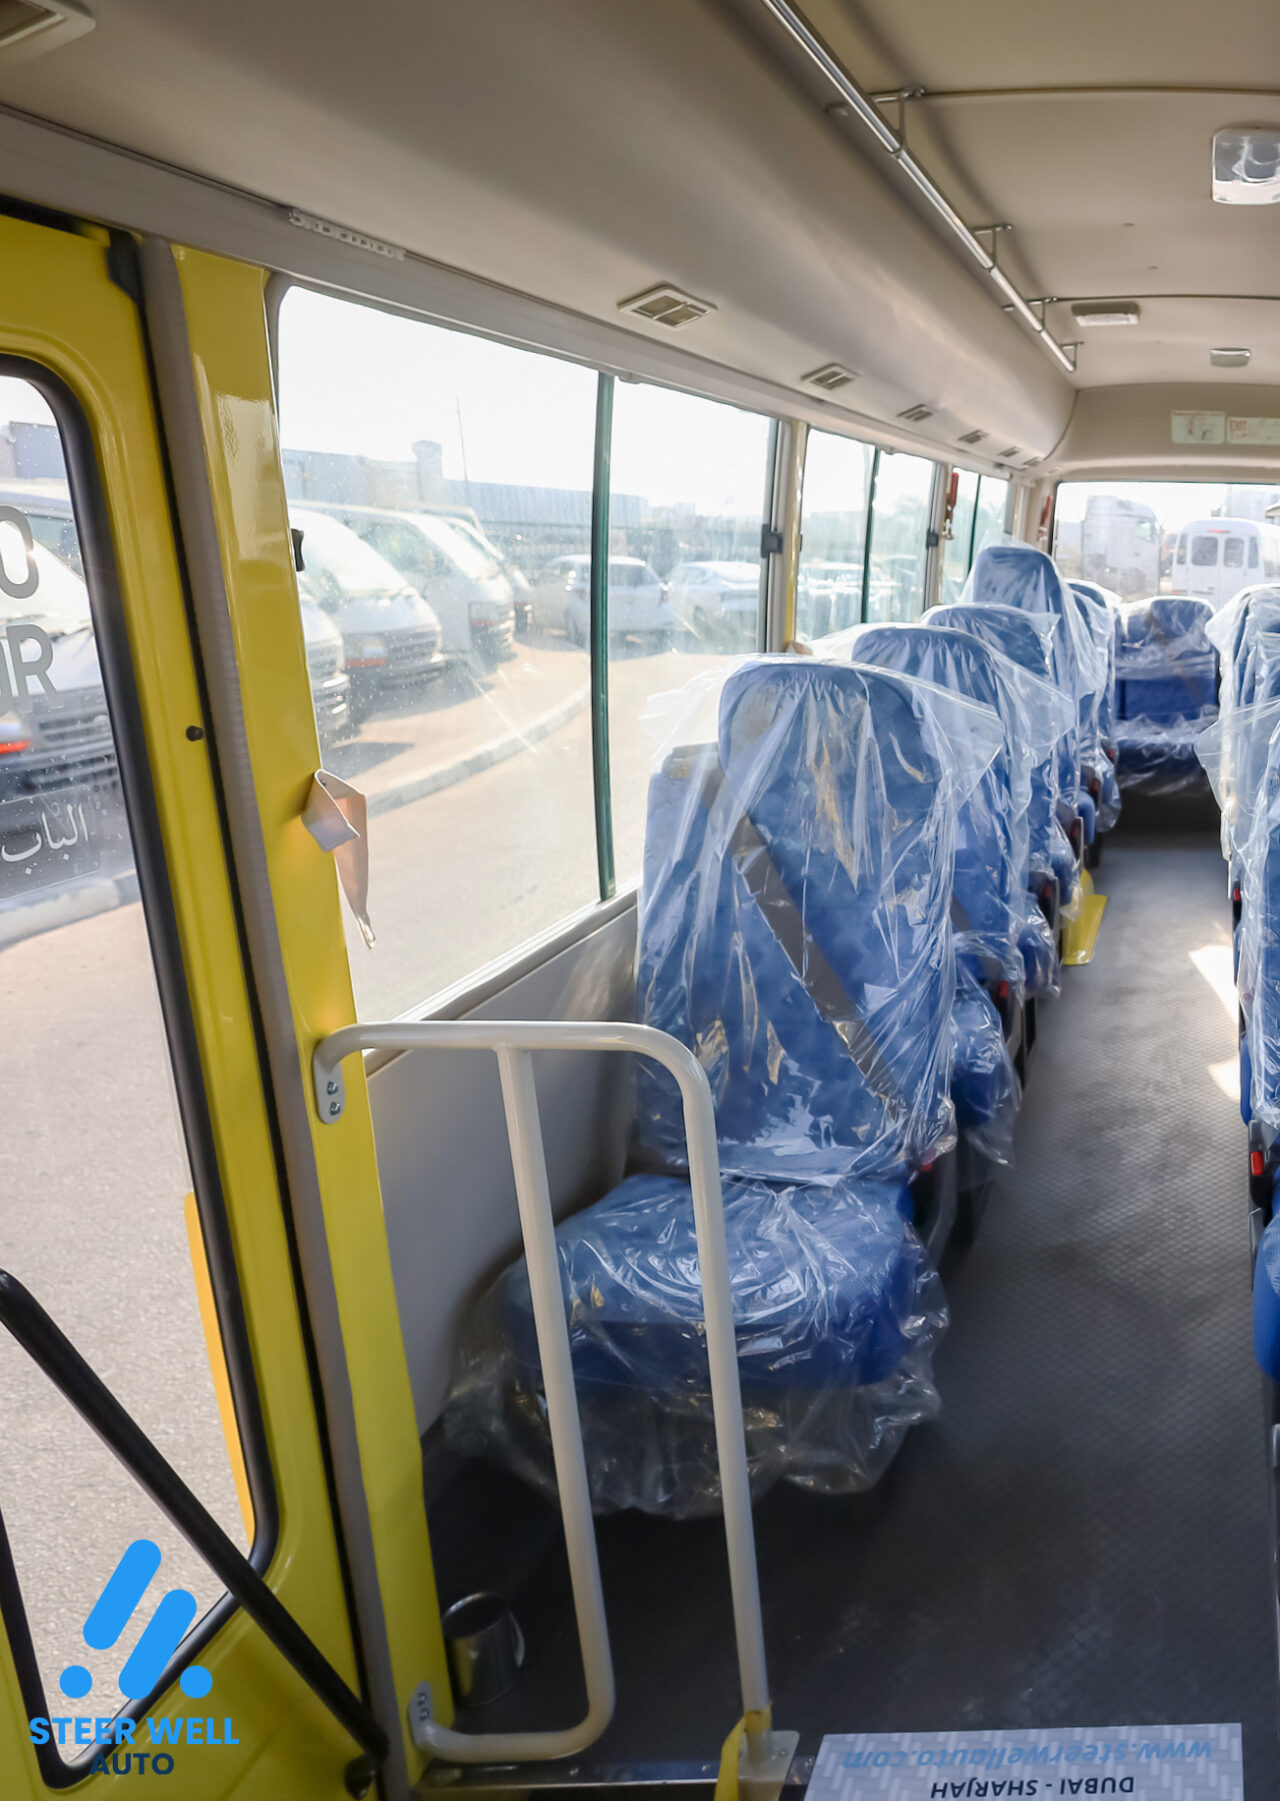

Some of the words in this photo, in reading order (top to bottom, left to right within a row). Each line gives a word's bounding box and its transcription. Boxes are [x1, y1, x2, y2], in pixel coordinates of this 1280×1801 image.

[1229, 420, 1247, 432] EXIT
[0, 624, 65, 717] R
[1, 803, 89, 875] الباب
[843, 1738, 1212, 1770] www.steerwellauto.com
[930, 1778, 1039, 1799] SHARJAH
[1058, 1776, 1135, 1795] DUBAI
